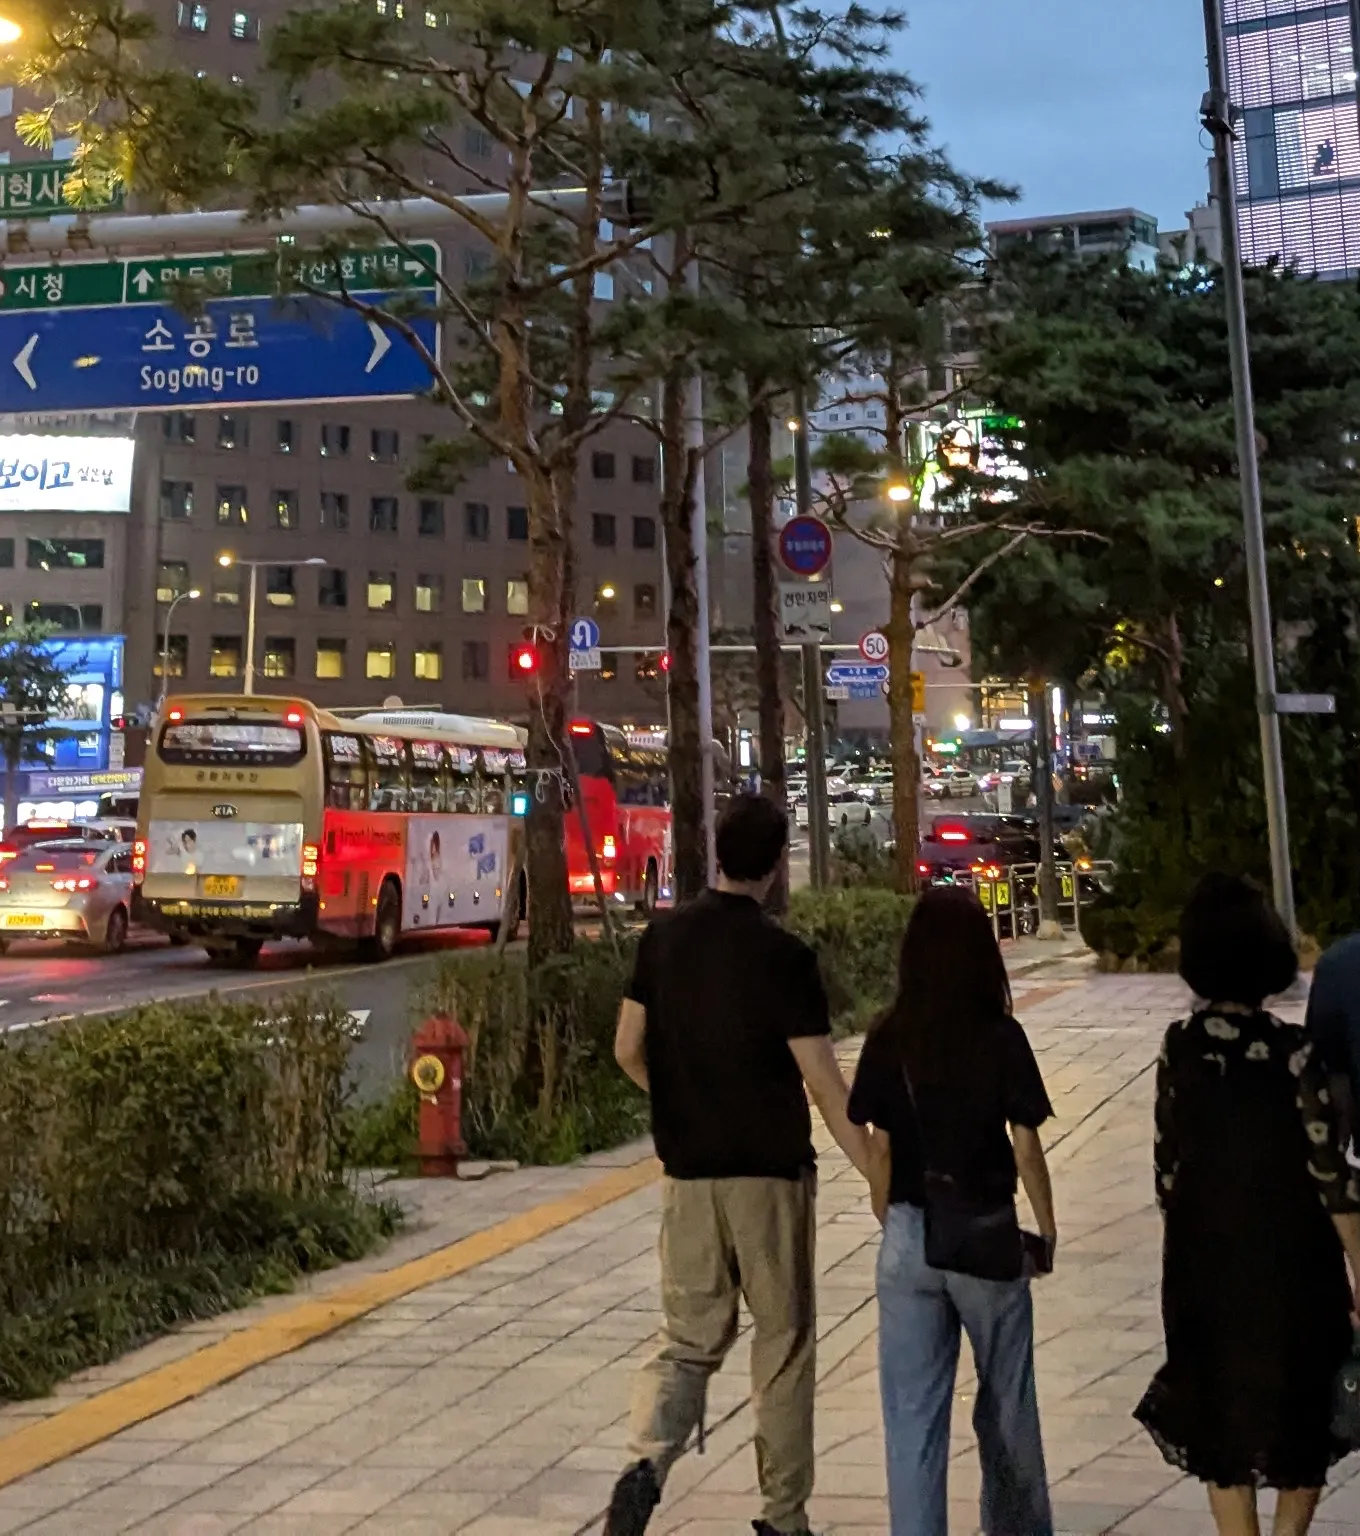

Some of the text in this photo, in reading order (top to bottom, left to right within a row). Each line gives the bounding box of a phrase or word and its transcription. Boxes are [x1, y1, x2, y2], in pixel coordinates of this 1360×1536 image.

[14, 272, 64, 302] 시청
[142, 314, 259, 357] 소공로
[141, 364, 259, 393] Sogong-ro
[866, 642, 885, 655] 50
[215, 805, 234, 815] KIA
